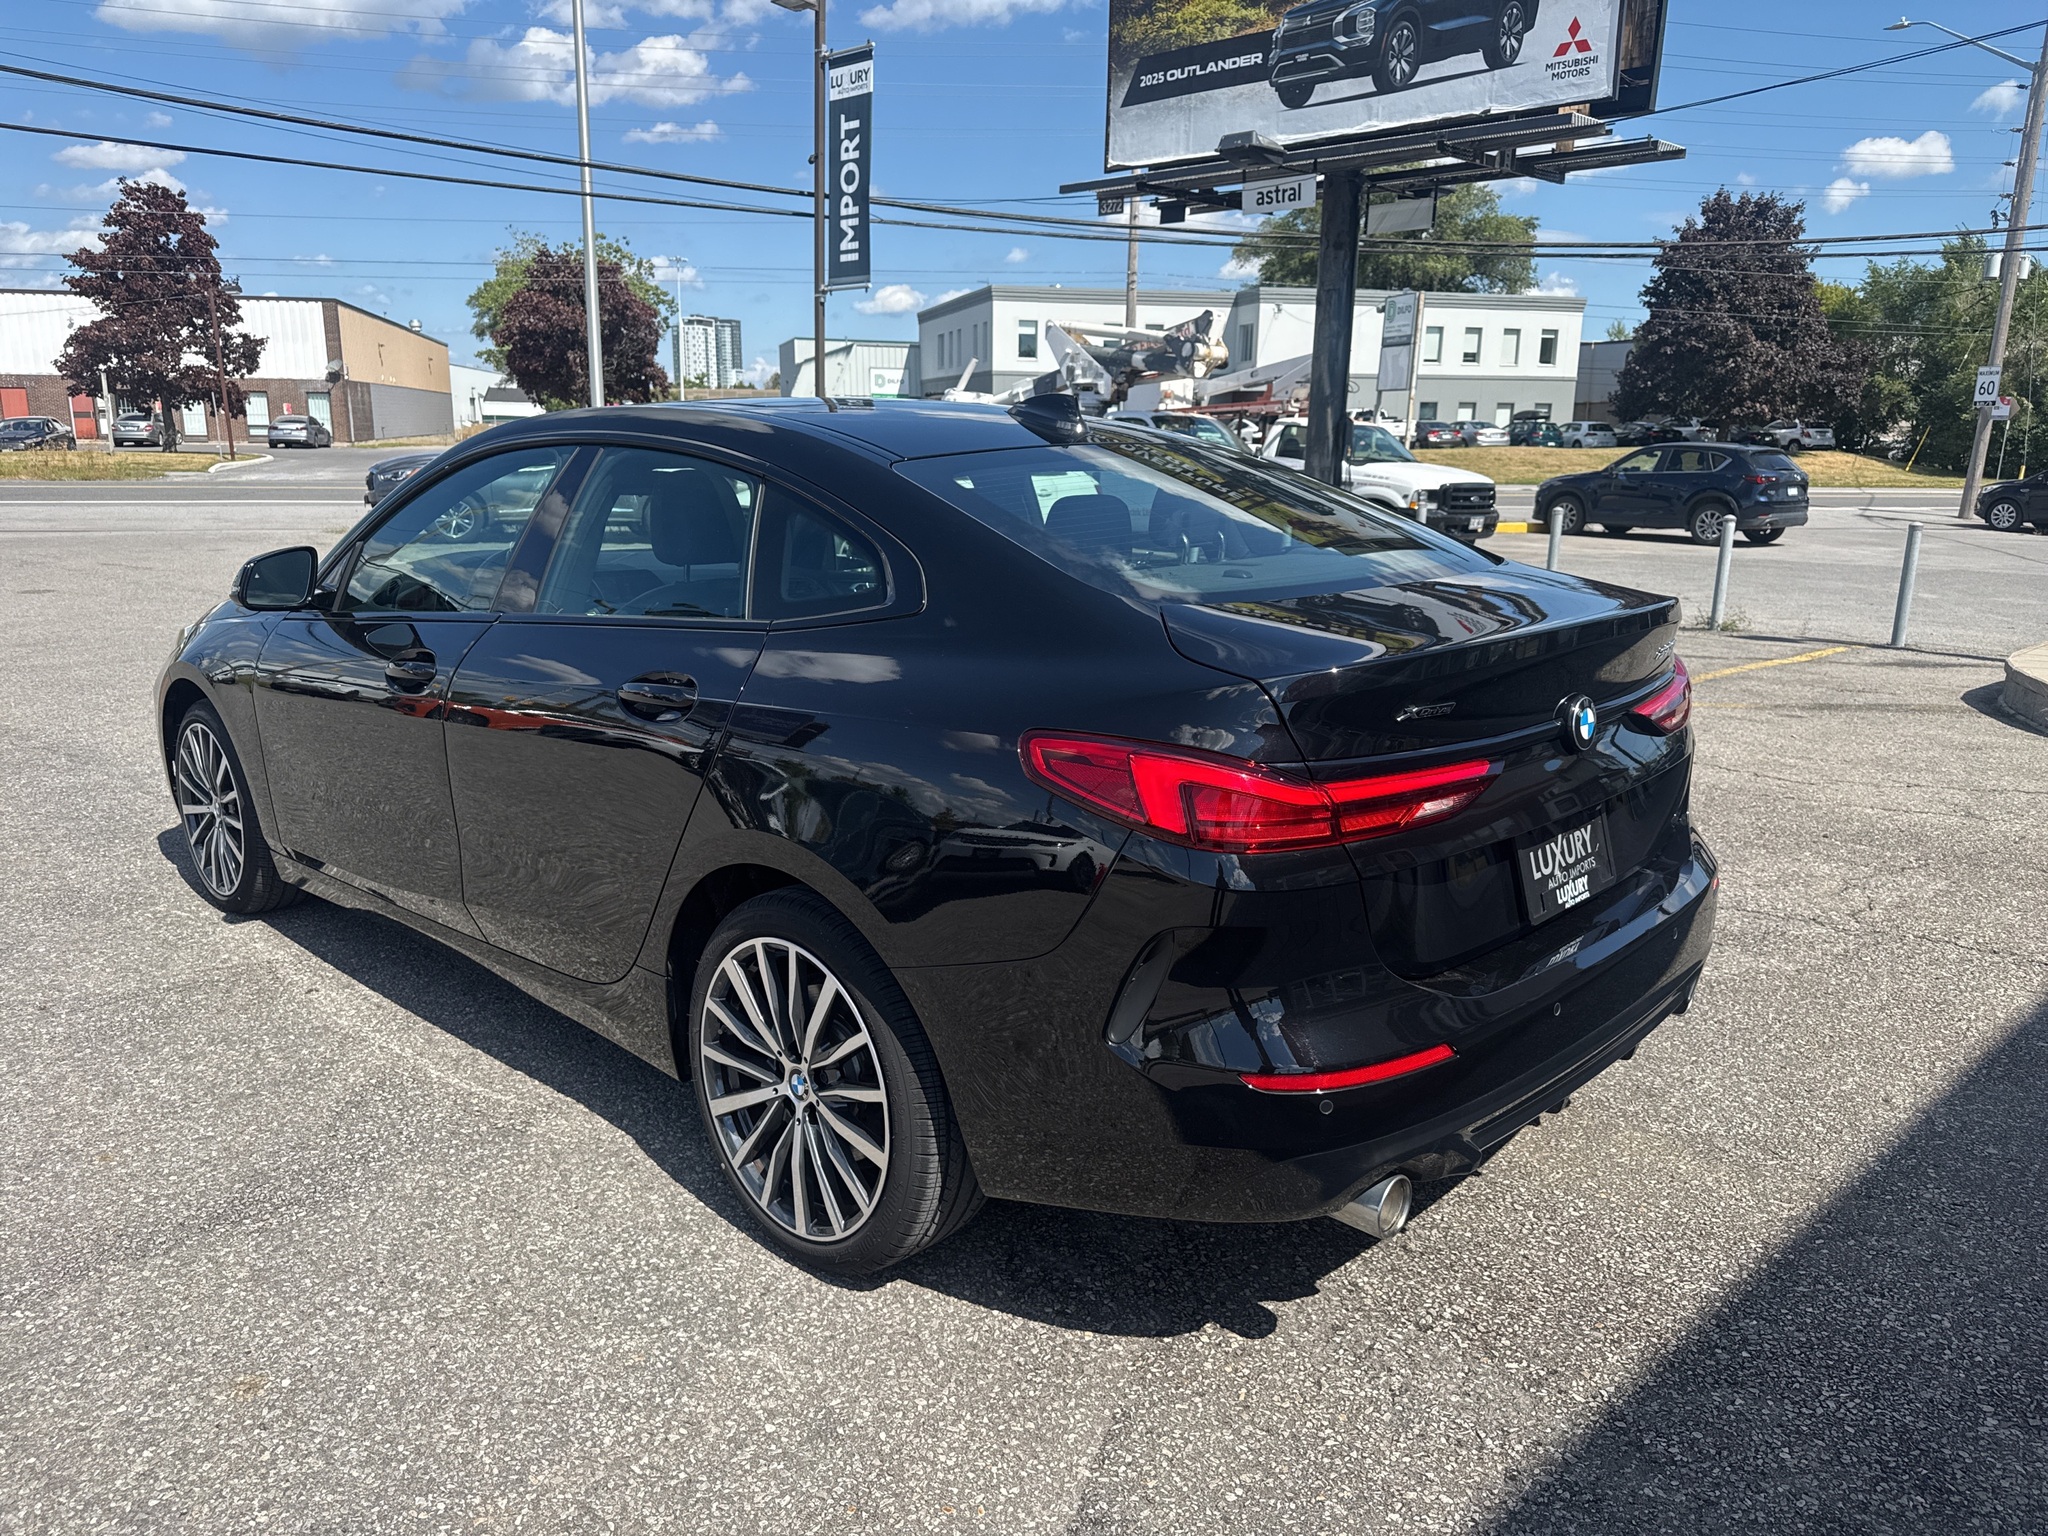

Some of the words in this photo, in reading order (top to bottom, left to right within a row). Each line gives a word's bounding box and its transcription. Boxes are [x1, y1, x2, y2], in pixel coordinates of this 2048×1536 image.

[1140, 72, 1164, 87] 2025
[1166, 53, 1263, 81] OUTLANDER
[1545, 55, 1599, 72] MITSUBISHI
[1551, 67, 1591, 81] MOTORS
[831, 67, 870, 89] LUURY
[840, 114, 860, 262] IMPORT
[1256, 183, 1302, 206] astral
[1100, 200, 1123, 213] 3272
[1978, 380, 1996, 396] 60
[1530, 824, 1592, 880] LUXURY
[1548, 871, 1569, 890] AUTO
[1568, 856, 1596, 880] IMPORTS
[1556, 875, 1588, 904] LUXURY
